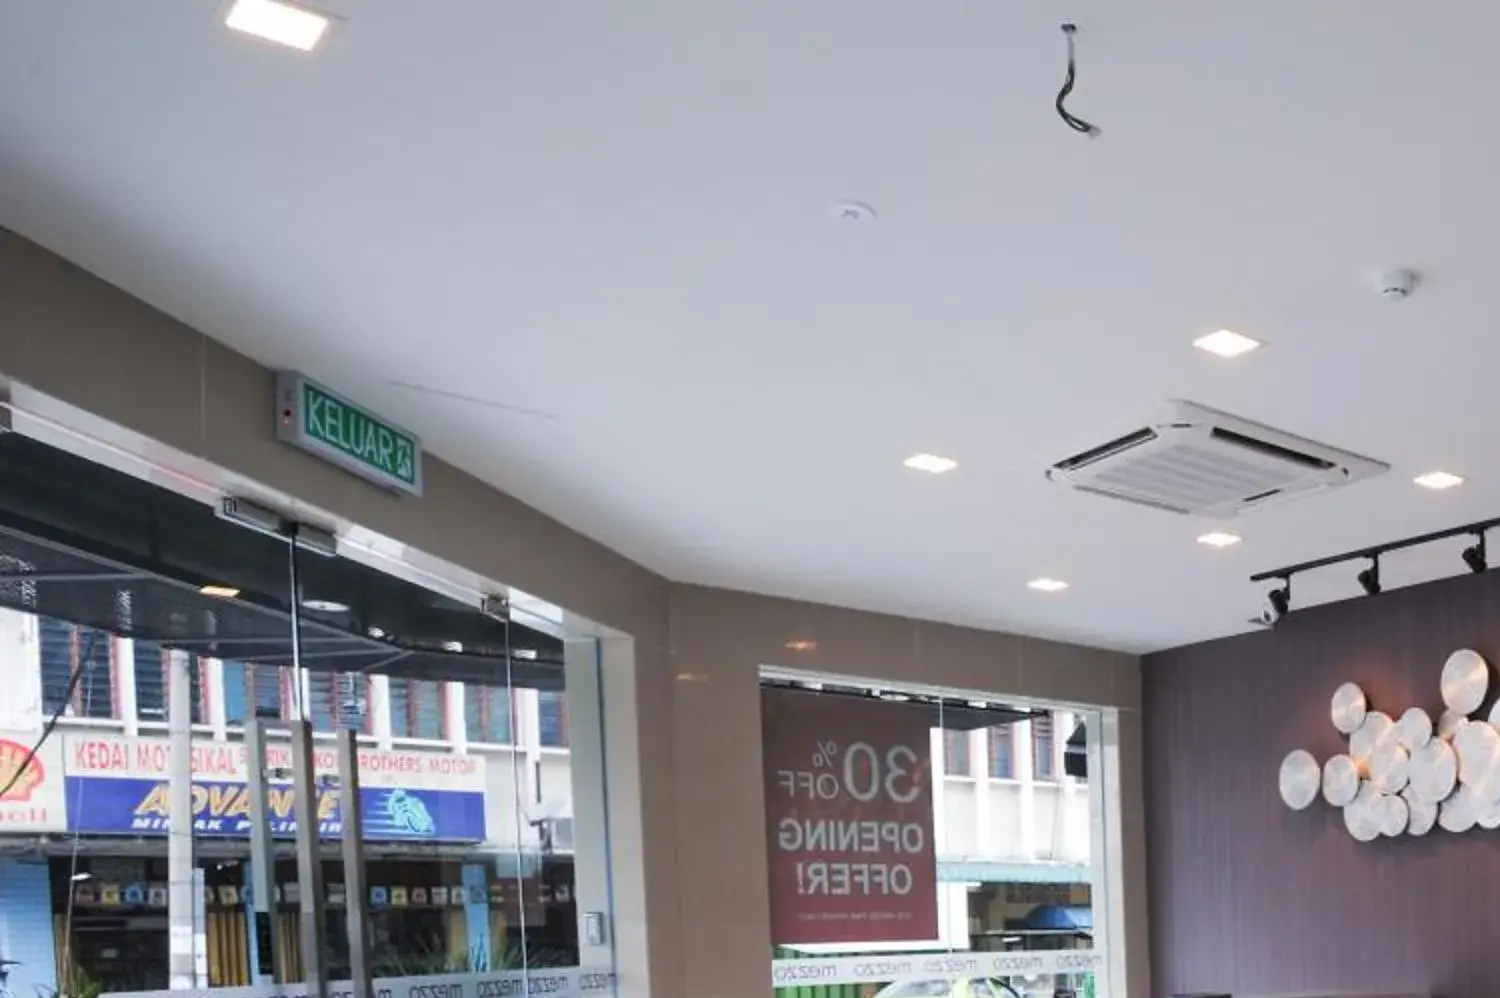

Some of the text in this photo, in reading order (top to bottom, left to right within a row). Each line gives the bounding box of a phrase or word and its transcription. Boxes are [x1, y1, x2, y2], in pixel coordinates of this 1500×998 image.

[307, 390, 393, 470] KELUAR
[74, 740, 129, 770] KEDAI
[356, 754, 422, 773] ROTHERS
[429, 757, 477, 774] MOTOR
